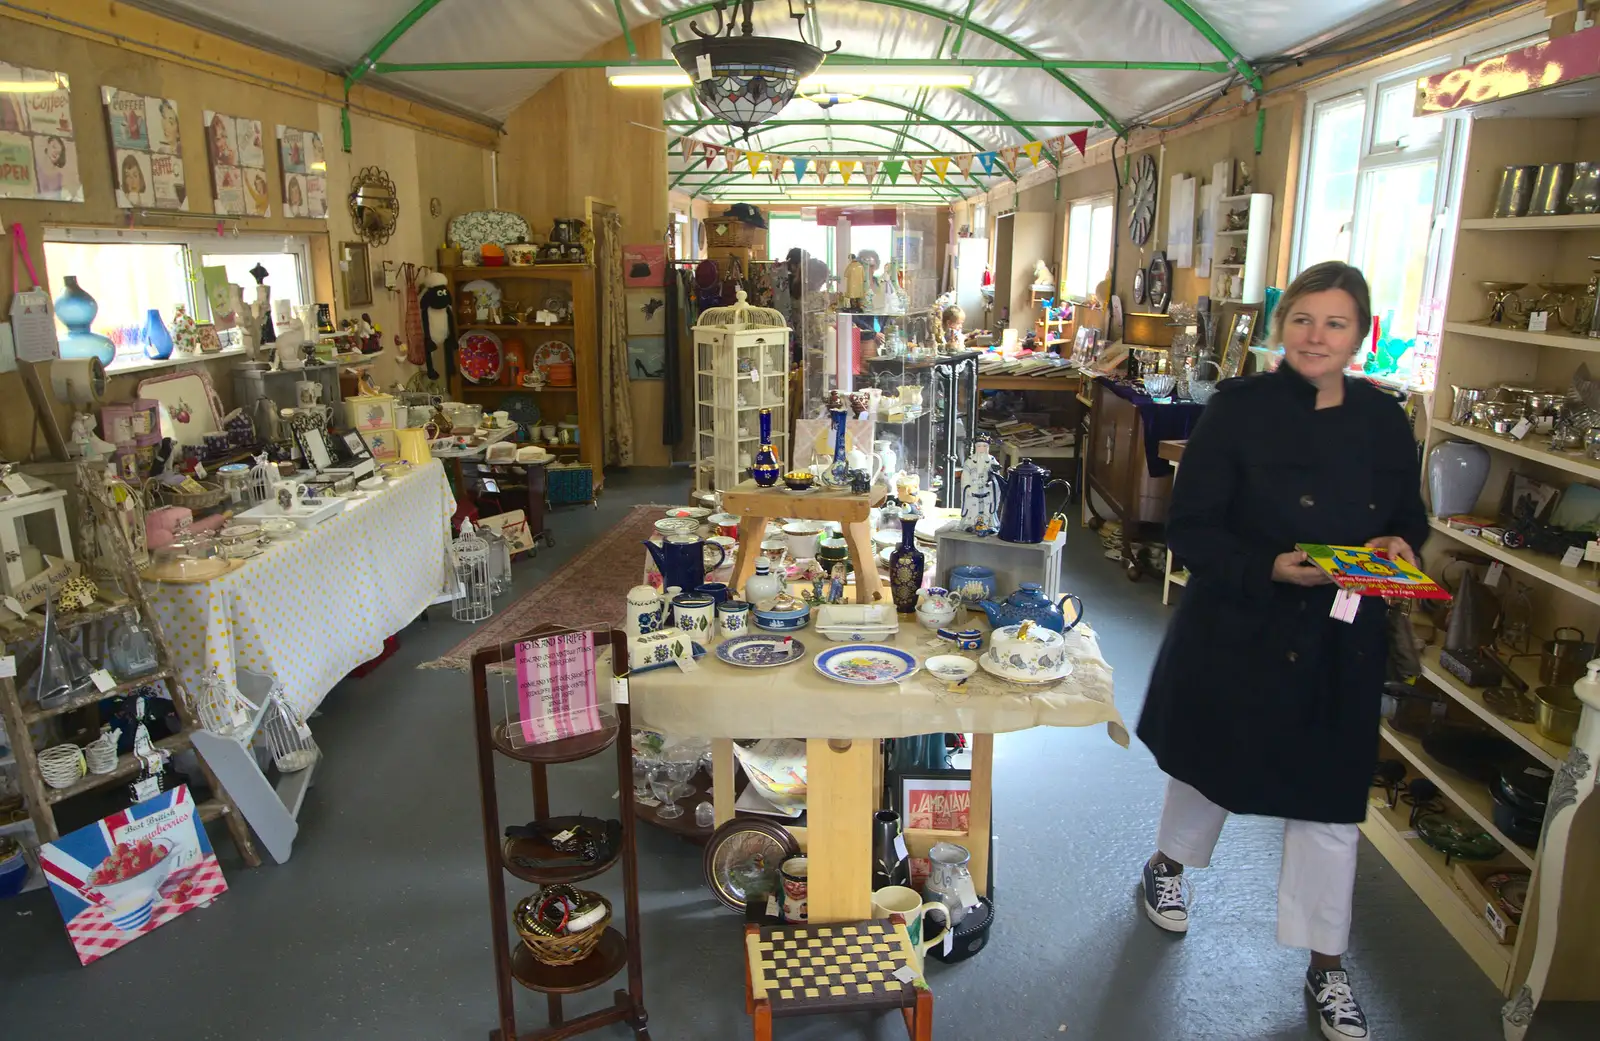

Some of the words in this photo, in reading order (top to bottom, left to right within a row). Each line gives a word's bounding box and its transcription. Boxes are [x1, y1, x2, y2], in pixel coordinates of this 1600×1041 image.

[520, 640, 540, 652] DOTS
[540, 638, 556, 648] AND
[557, 632, 587, 645] STRIPES
[912, 791, 970, 818] JAMBALAYA
[125, 821, 145, 835] Best
[147, 808, 176, 826] British
